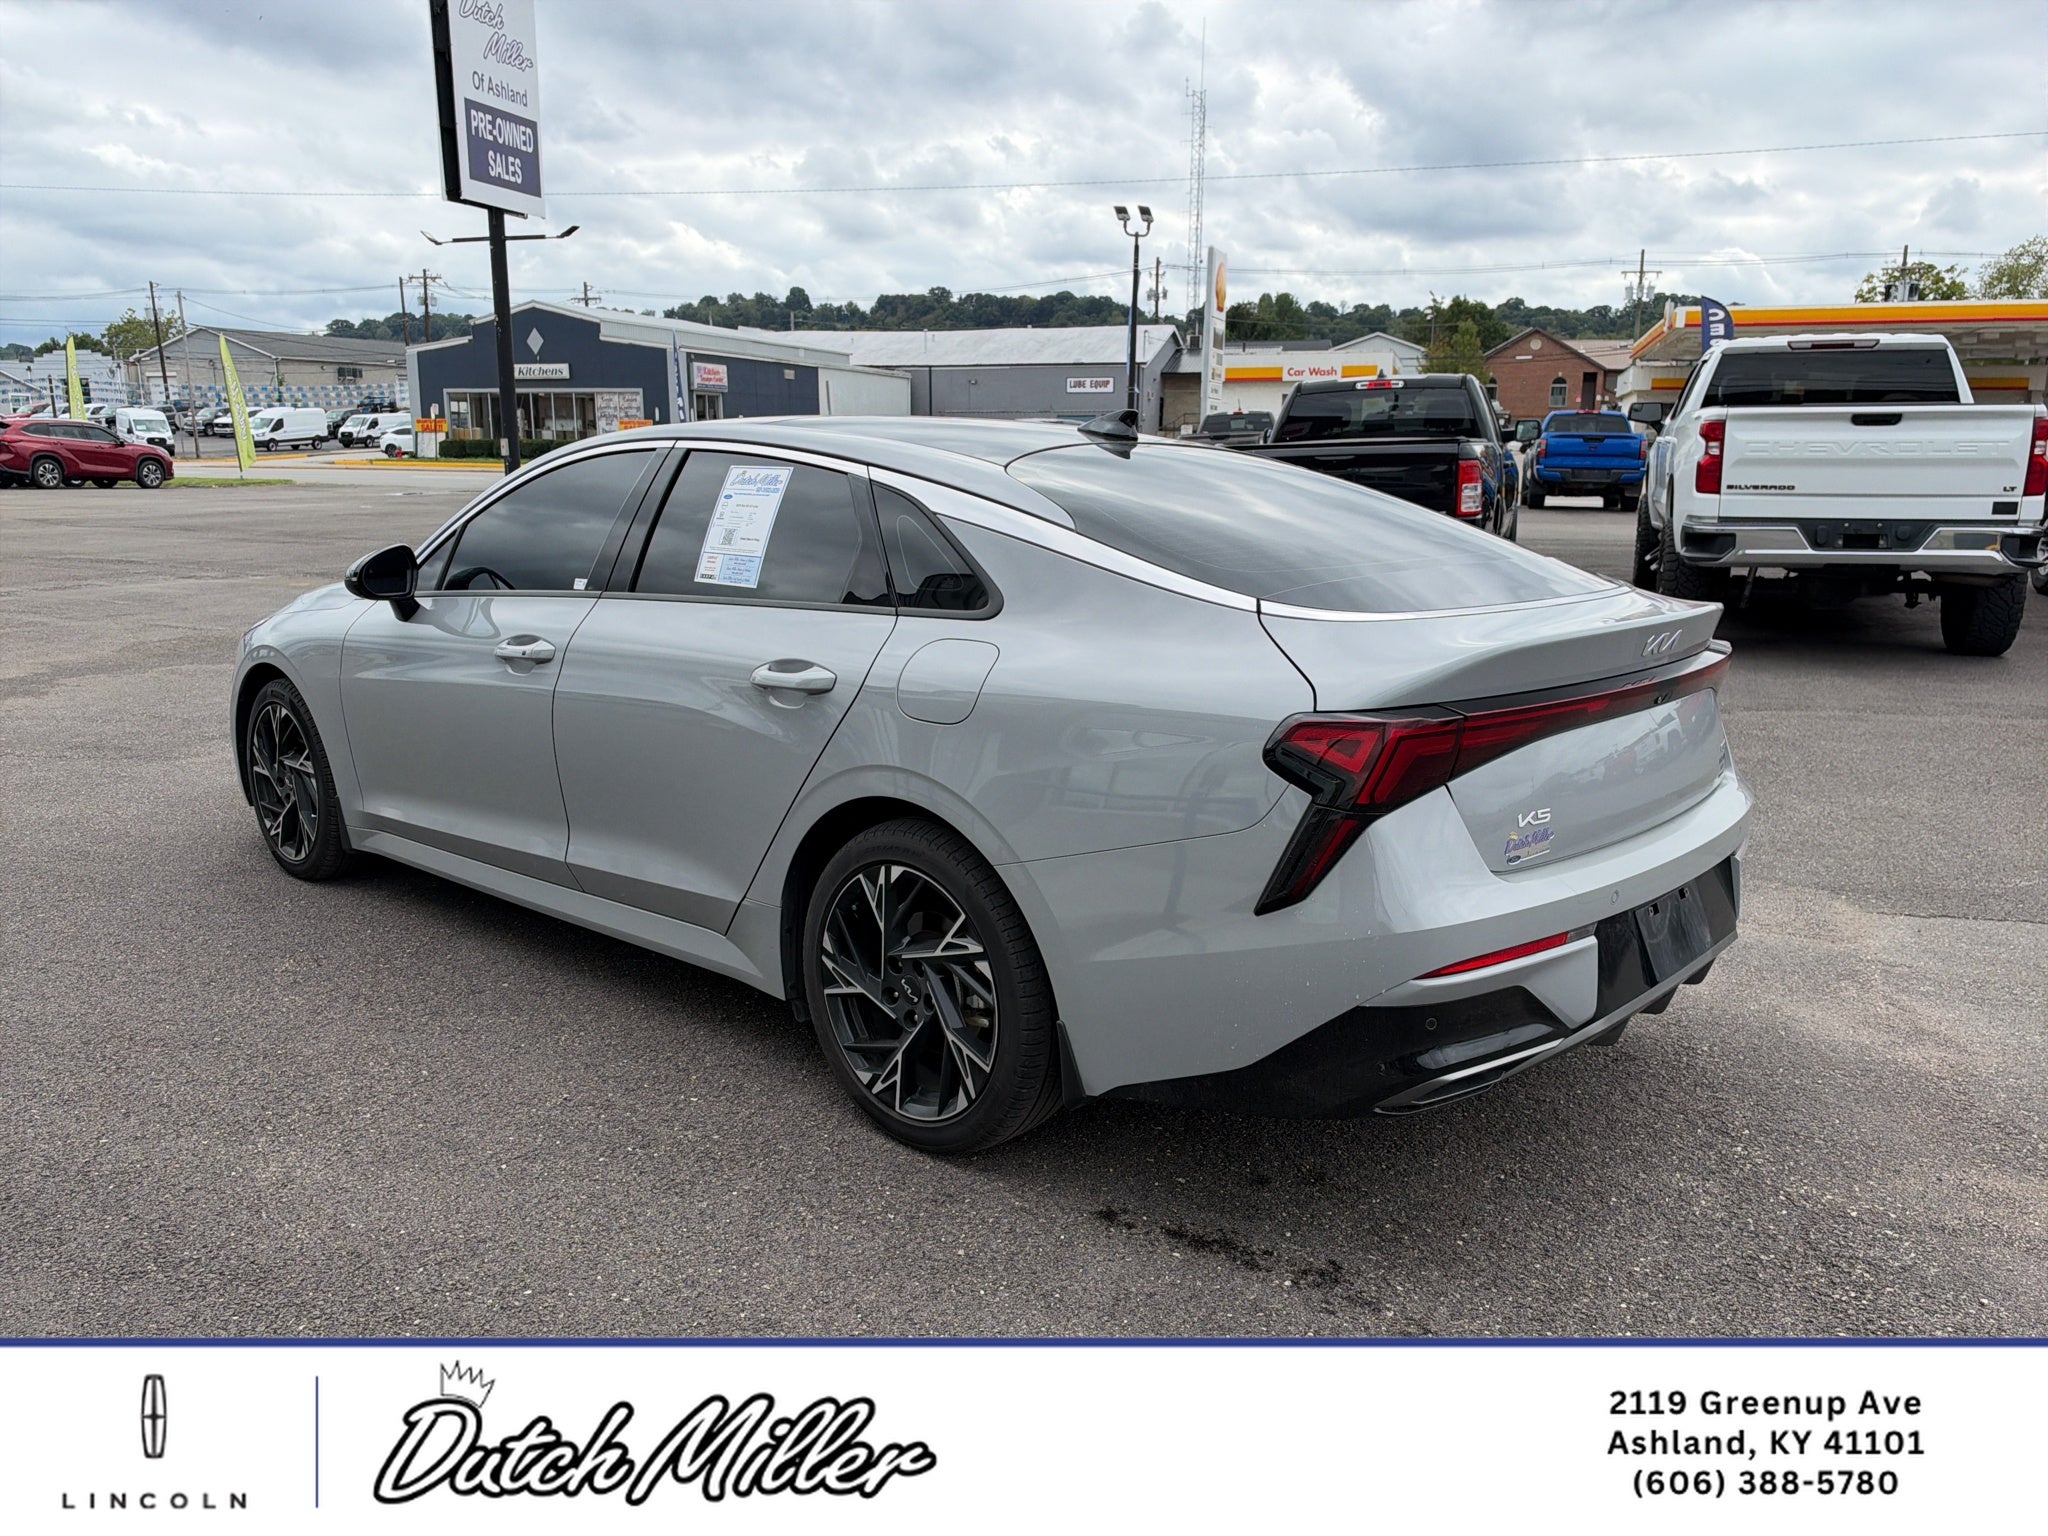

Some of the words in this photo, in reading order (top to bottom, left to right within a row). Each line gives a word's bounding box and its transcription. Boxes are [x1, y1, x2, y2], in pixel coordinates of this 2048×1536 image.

[459, 0, 504, 30] Dutch
[483, 31, 534, 72] Miller
[472, 70, 485, 91] Of
[487, 78, 528, 107] Ashland
[470, 109, 534, 153] PRE-OWNED
[488, 151, 523, 185] SALES
[518, 366, 564, 377] Kitchens
[1287, 367, 1305, 377] Car
[1308, 365, 1338, 377] Wash
[1069, 379, 1087, 389] LUBE
[1089, 379, 1110, 390] EQUIP
[1744, 440, 2011, 456] CHEVROLET
[1517, 807, 1552, 828] K5
